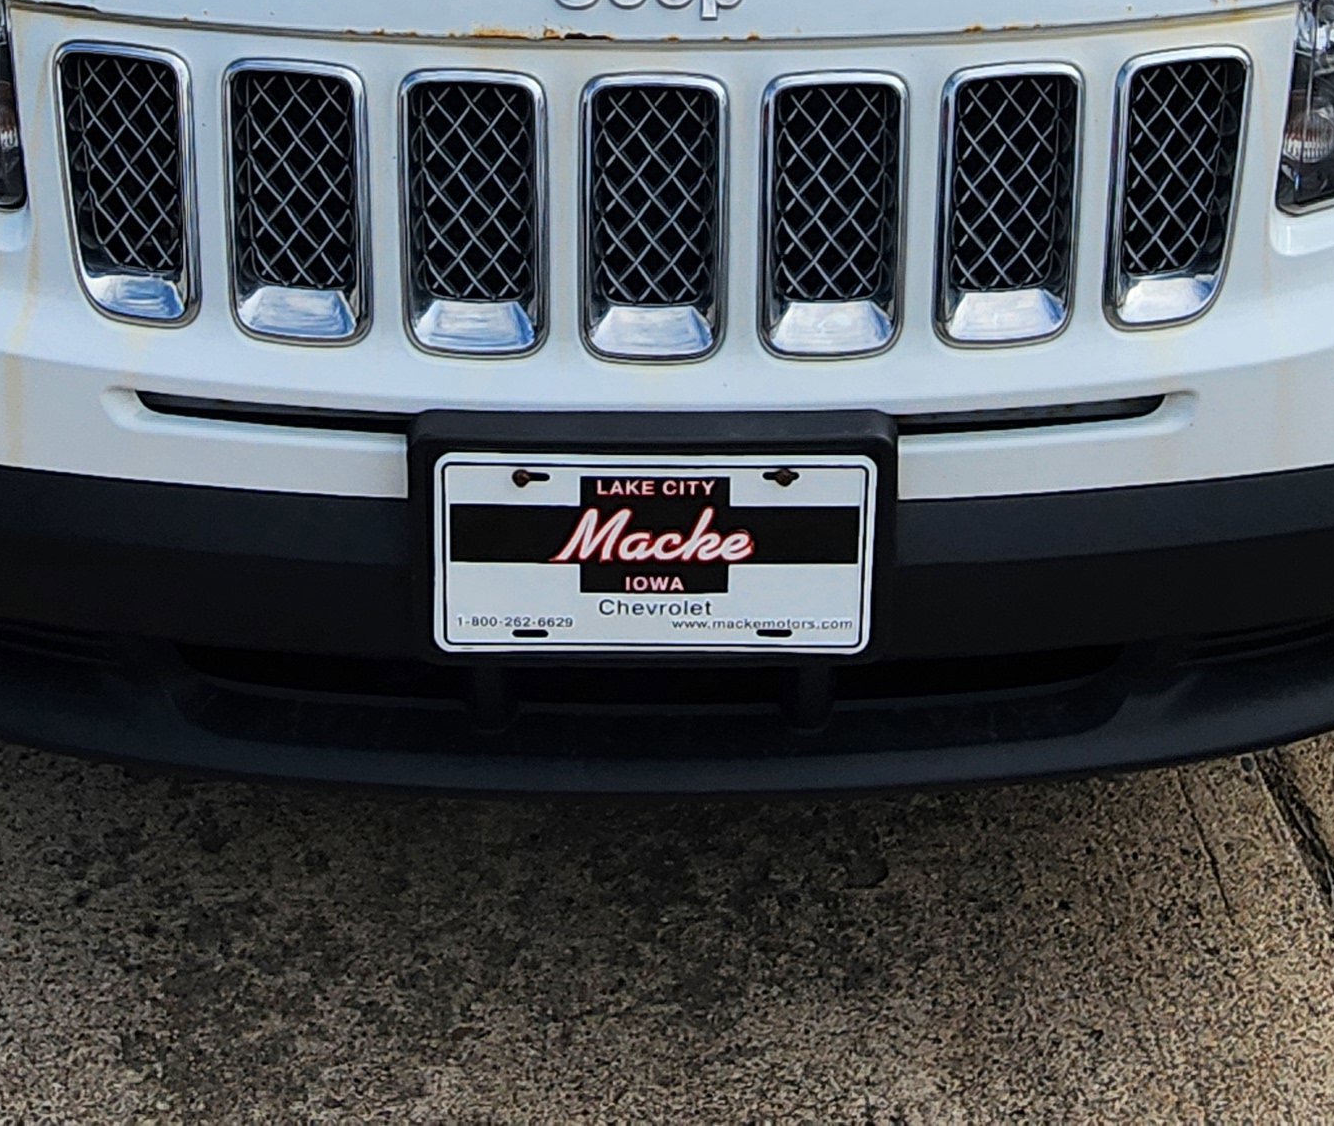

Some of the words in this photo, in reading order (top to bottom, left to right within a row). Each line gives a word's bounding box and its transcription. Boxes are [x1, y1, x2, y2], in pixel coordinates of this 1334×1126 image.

[596, 479, 655, 496] LAKE
[661, 479, 717, 496] CITY
[547, 507, 755, 564] Macke
[625, 576, 685, 592] IOWA
[598, 599, 712, 617] Chevrolet
[456, 616, 574, 628] 1-800-262-6629
[671, 617, 854, 631] www.mackemotors.com
